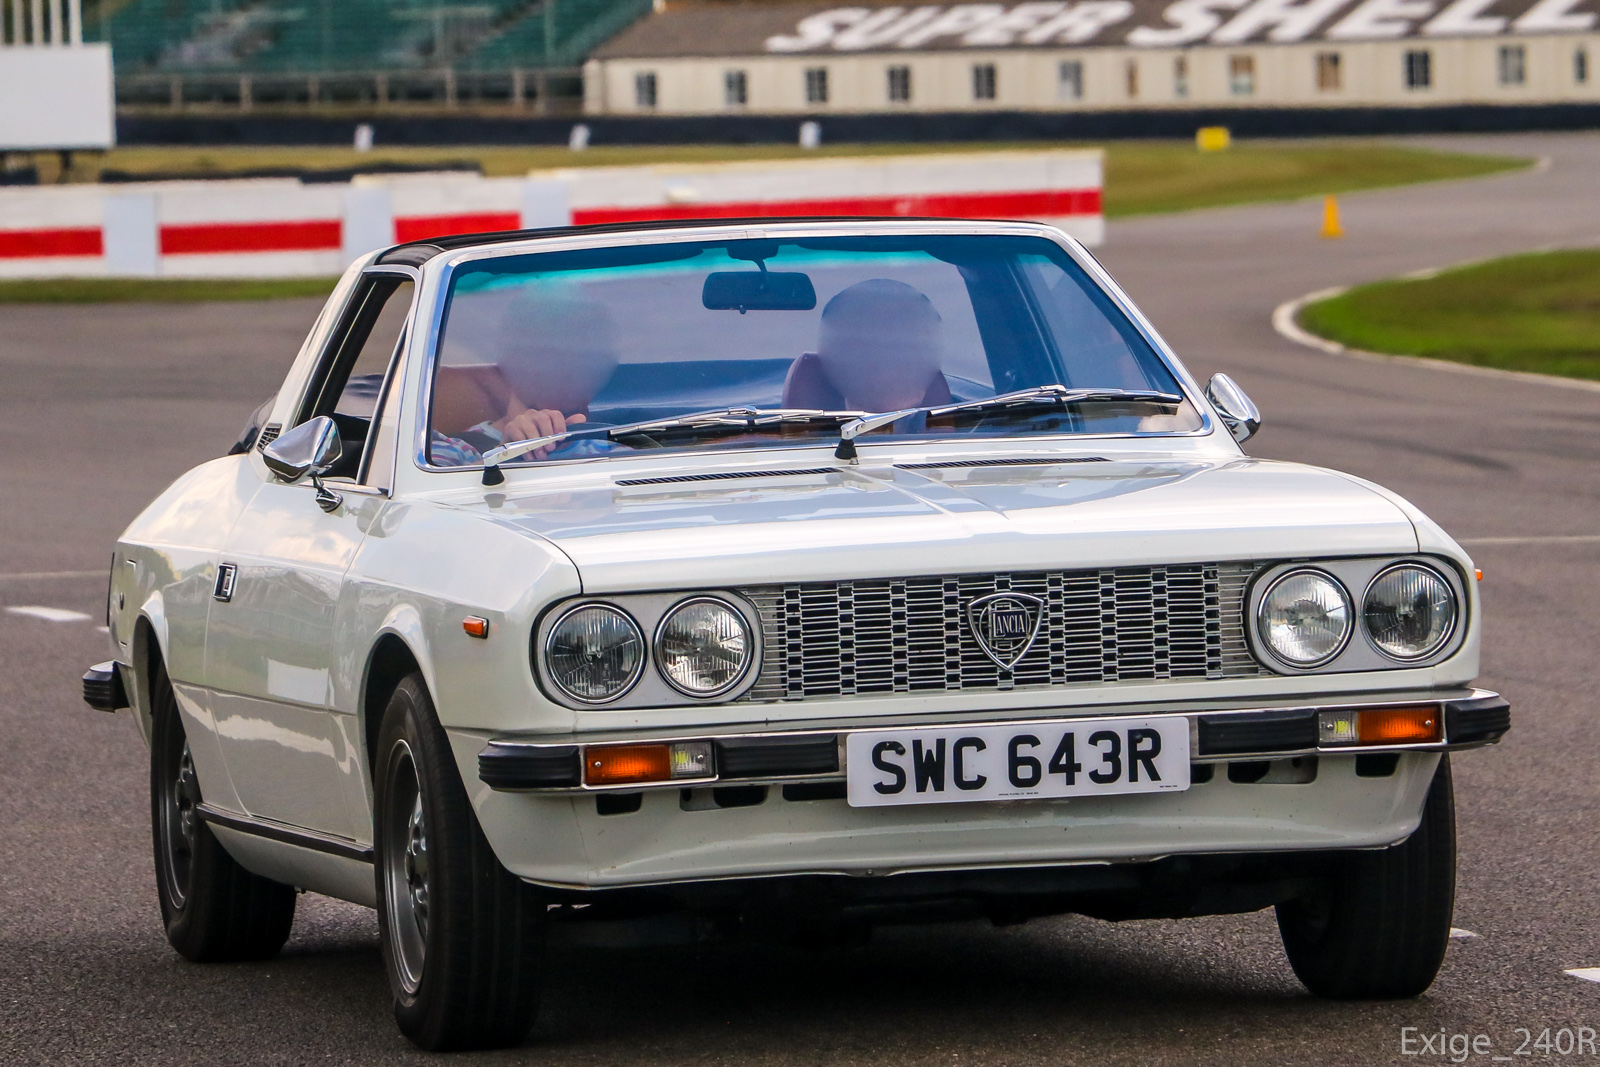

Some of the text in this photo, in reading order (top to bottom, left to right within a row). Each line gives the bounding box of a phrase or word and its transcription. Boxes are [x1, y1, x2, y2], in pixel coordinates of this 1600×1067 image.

[764, 0, 1596, 52] SUPER SHELL
[992, 612, 1026, 638] LANCIA
[871, 728, 1162, 795] SWC 643R
